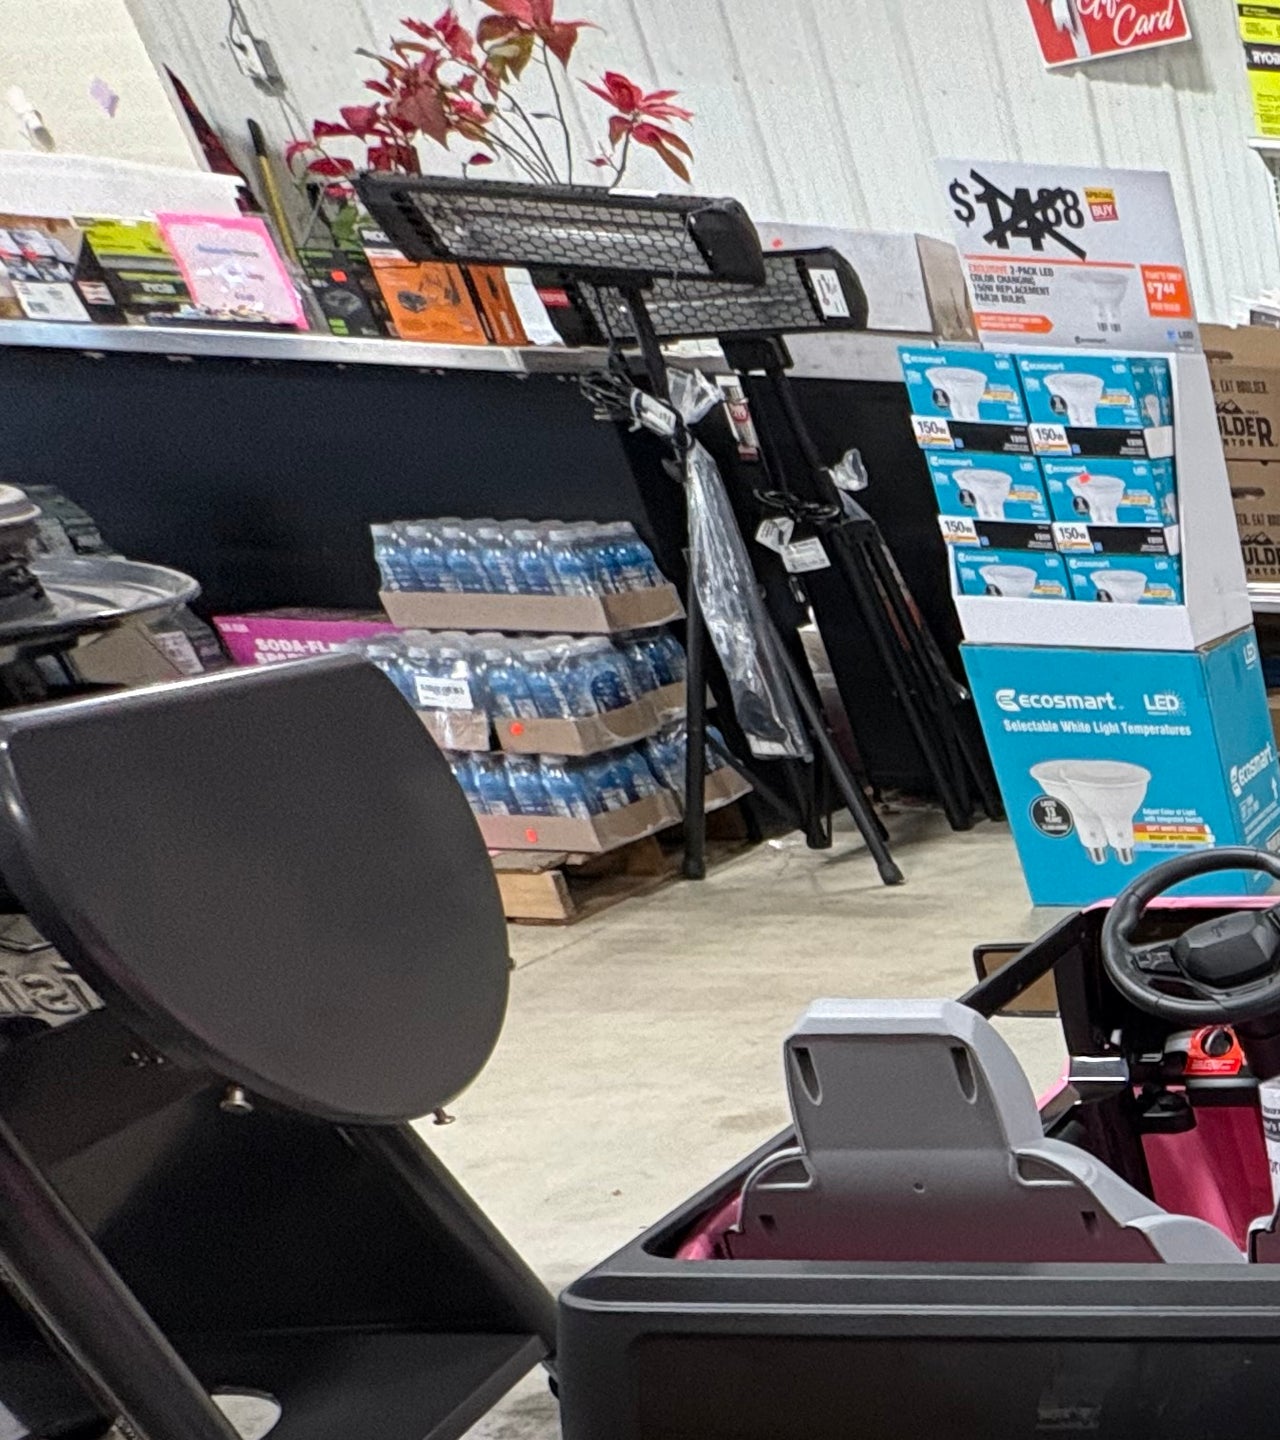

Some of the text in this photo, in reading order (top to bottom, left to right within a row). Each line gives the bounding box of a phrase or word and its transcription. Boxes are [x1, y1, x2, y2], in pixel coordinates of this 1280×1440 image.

[1113, 0, 1174, 46] Card
[1091, 204, 1114, 217] BUY
[1018, 691, 1180, 712] ecosmart LED
[1003, 719, 1192, 737] Selectable White Light Temperatures
